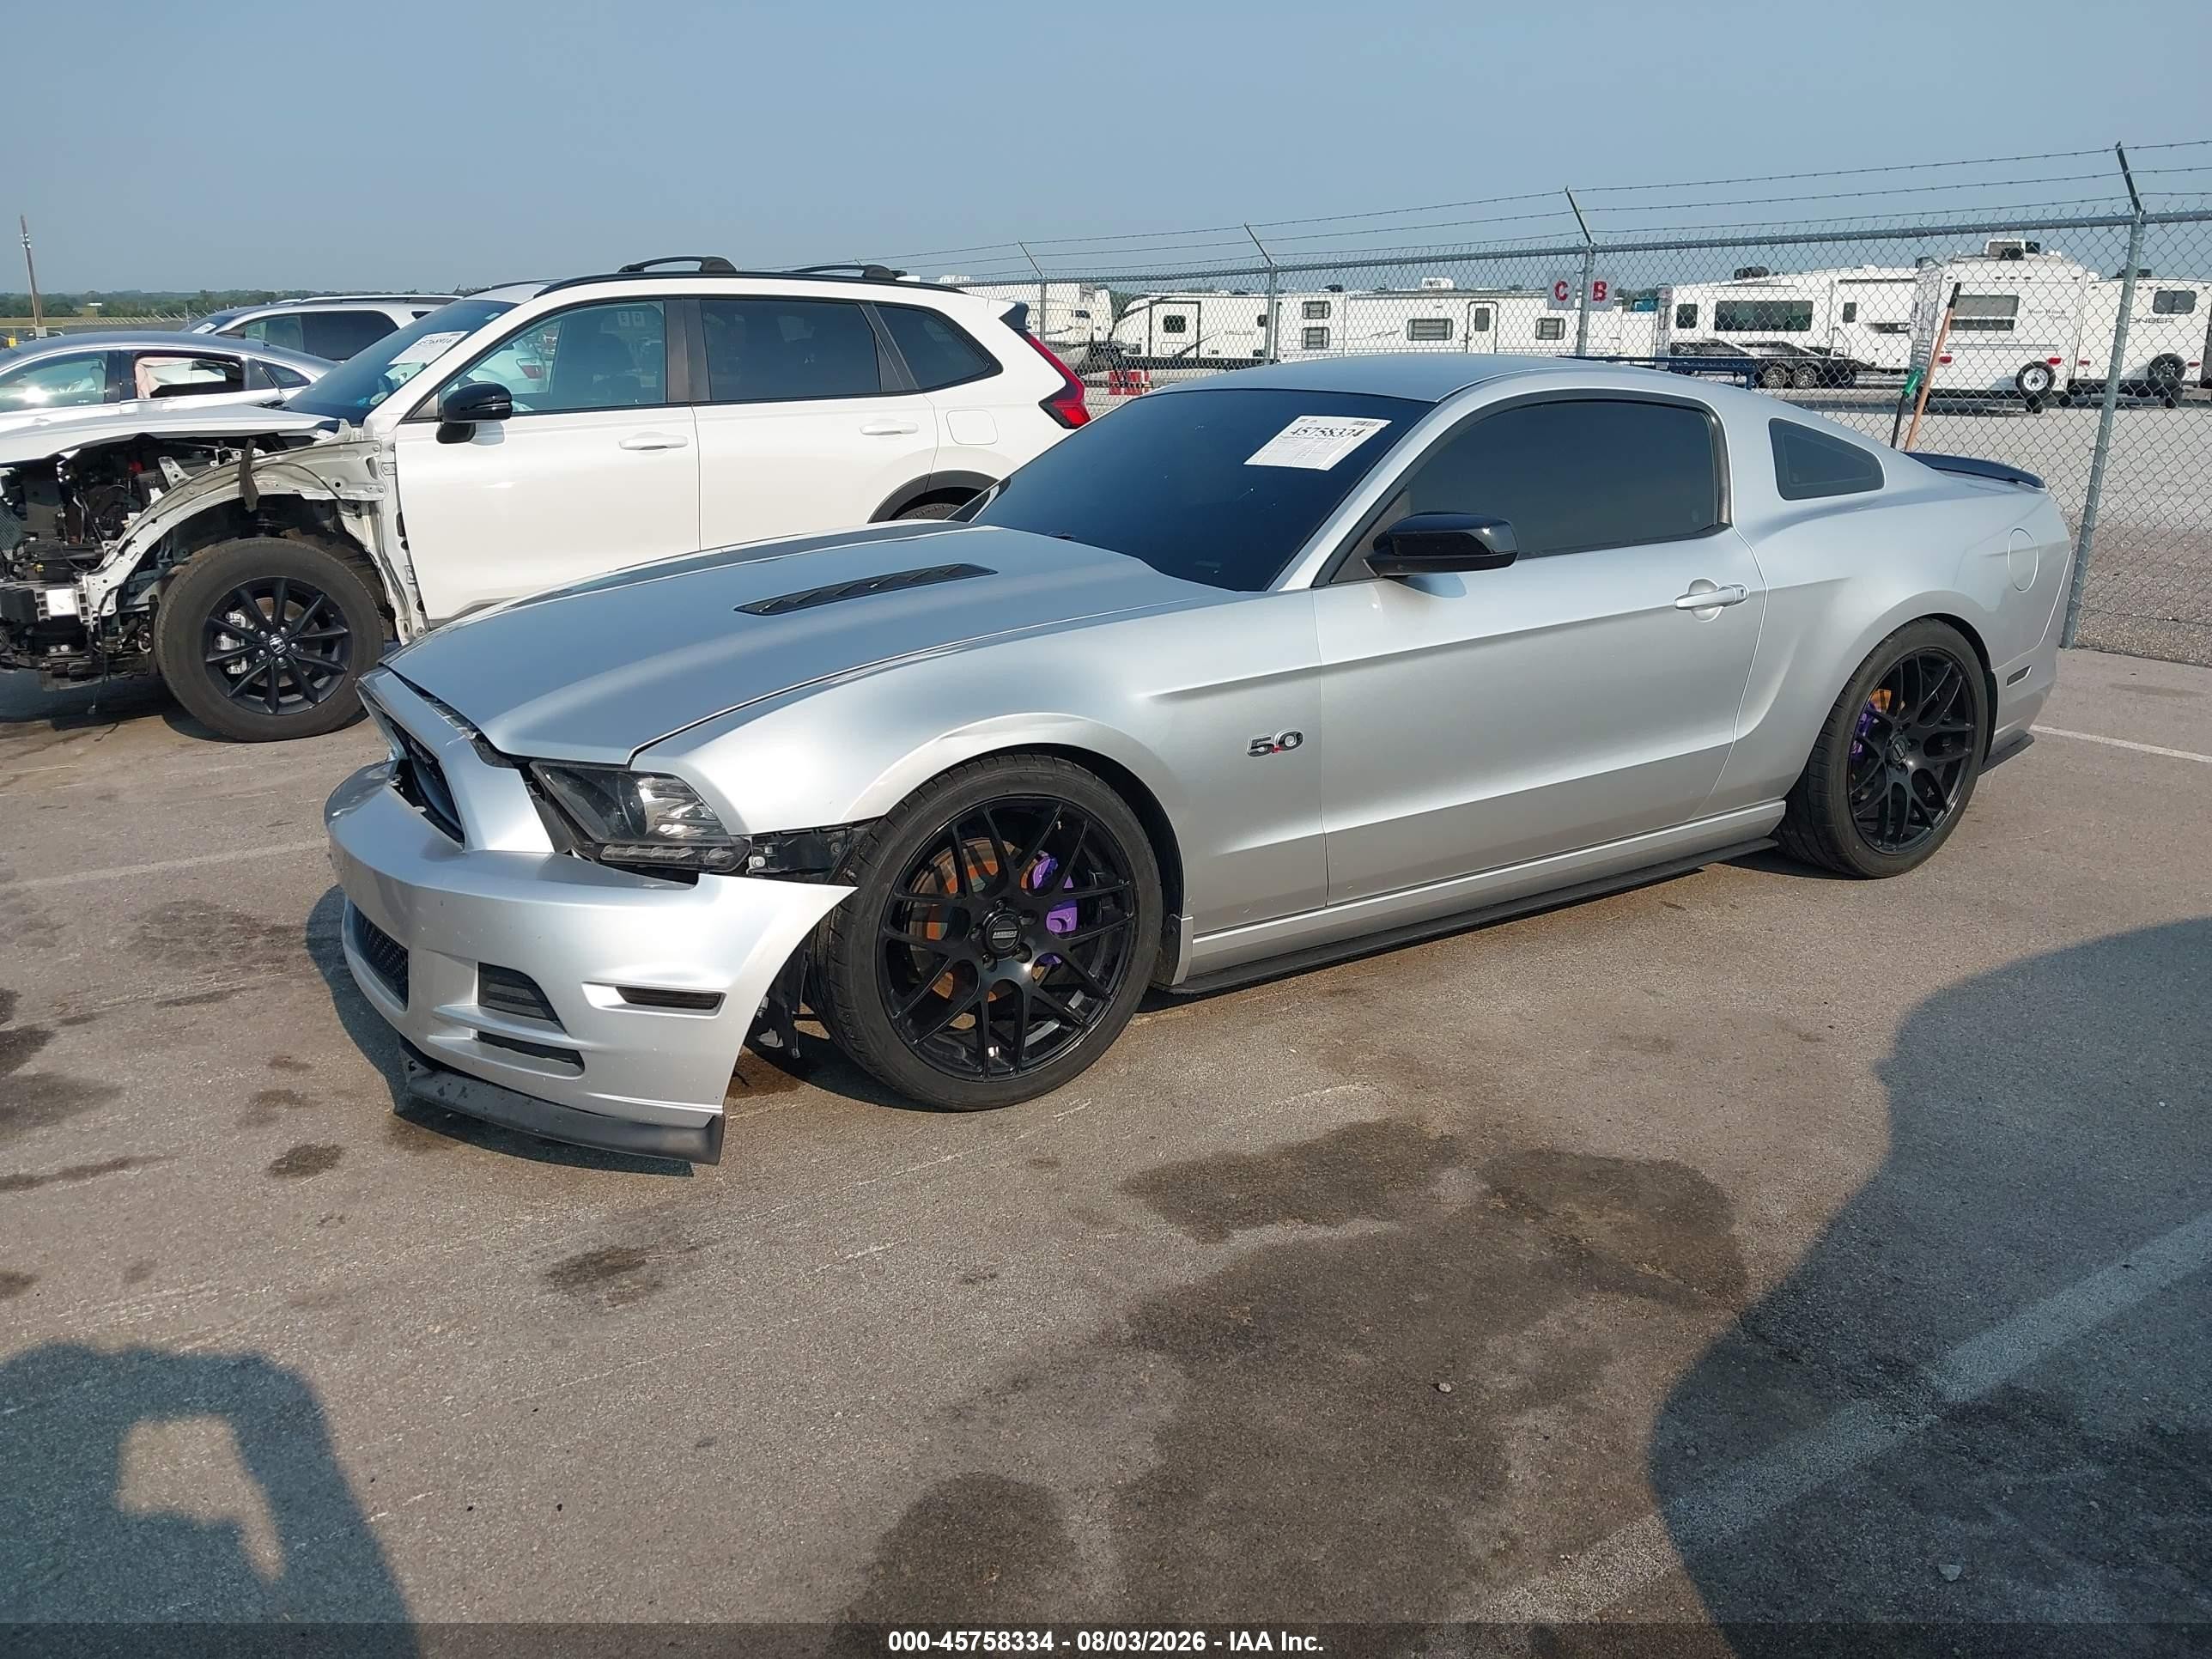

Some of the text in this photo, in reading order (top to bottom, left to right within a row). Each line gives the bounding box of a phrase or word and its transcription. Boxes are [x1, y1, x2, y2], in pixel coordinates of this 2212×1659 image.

[1554, 280, 1569, 301] C
[1593, 281, 1607, 301] B
[1246, 729, 1304, 757] 5.0
